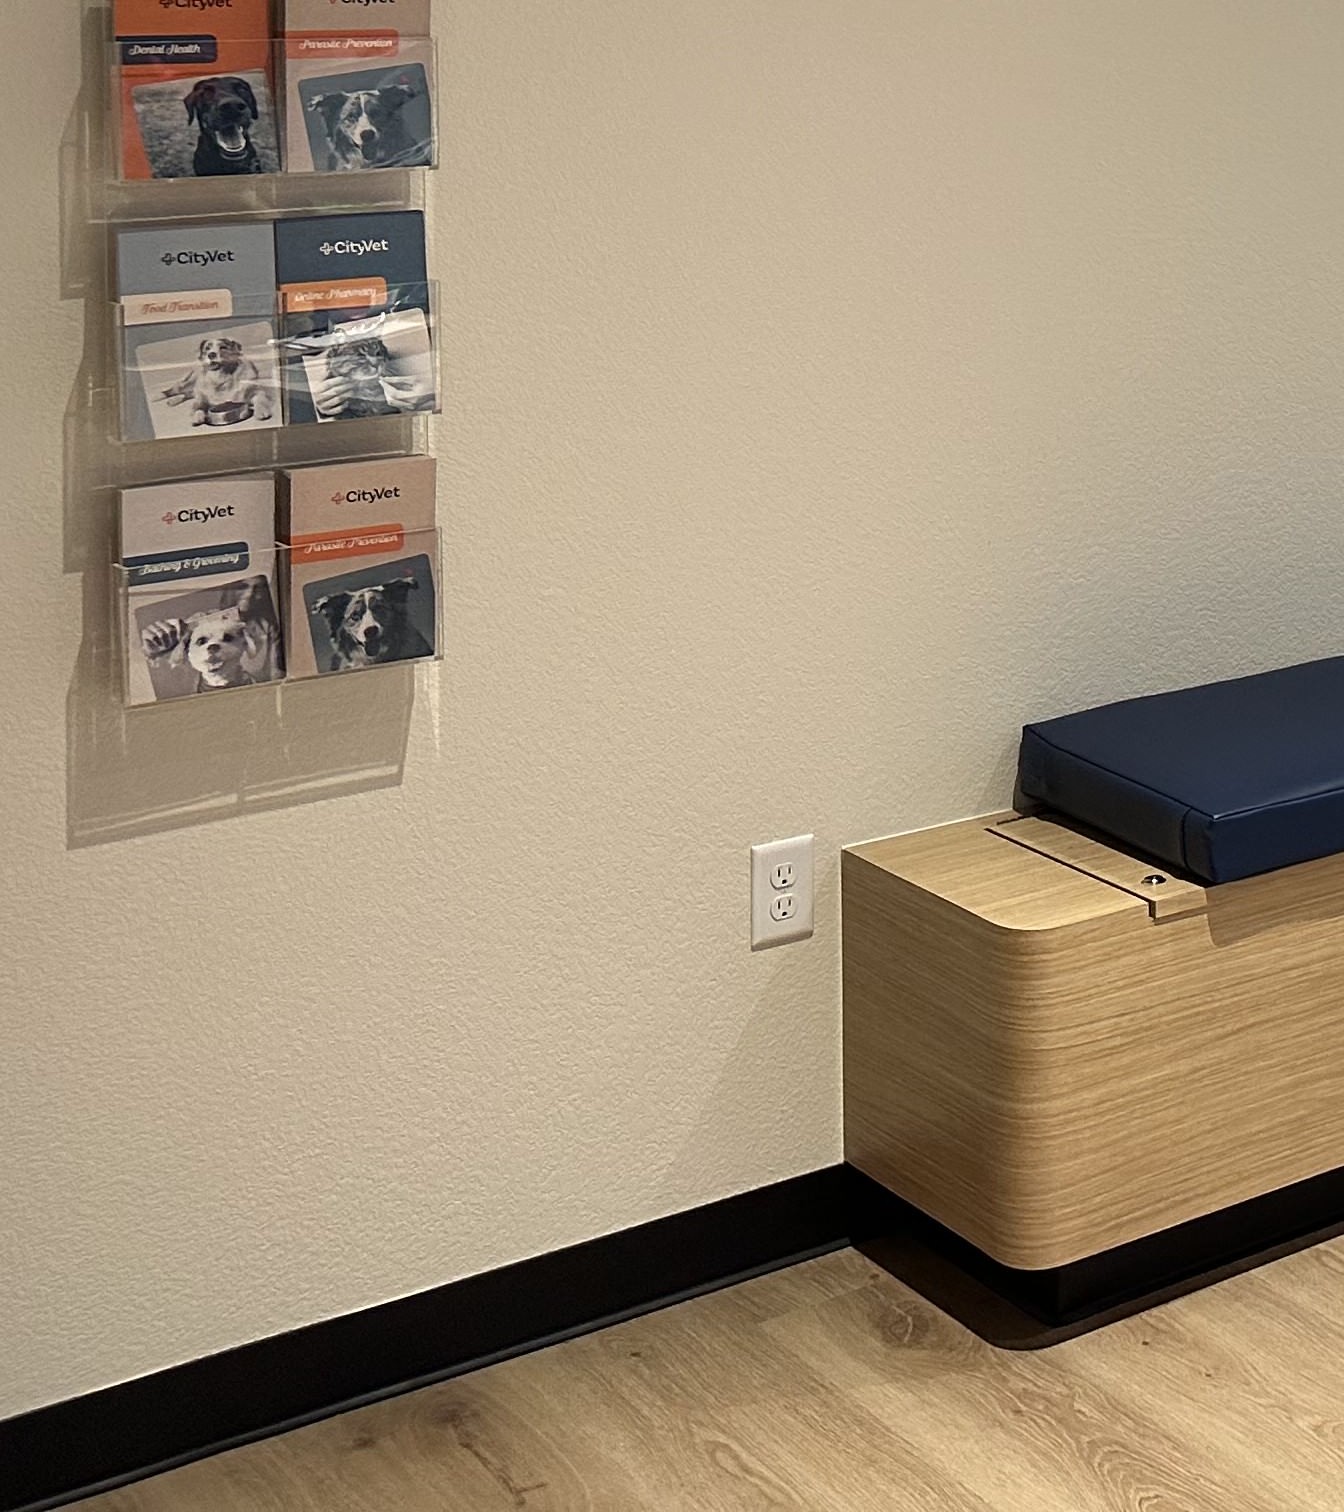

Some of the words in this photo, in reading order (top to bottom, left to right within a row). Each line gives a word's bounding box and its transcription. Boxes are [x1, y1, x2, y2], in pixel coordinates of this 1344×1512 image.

[128, 44, 164, 56] Dental
[165, 43, 201, 56] Health
[334, 239, 389, 256] CityVet
[177, 250, 236, 267] CityVet
[346, 486, 401, 503] CityVet
[178, 505, 235, 523] CityVet
